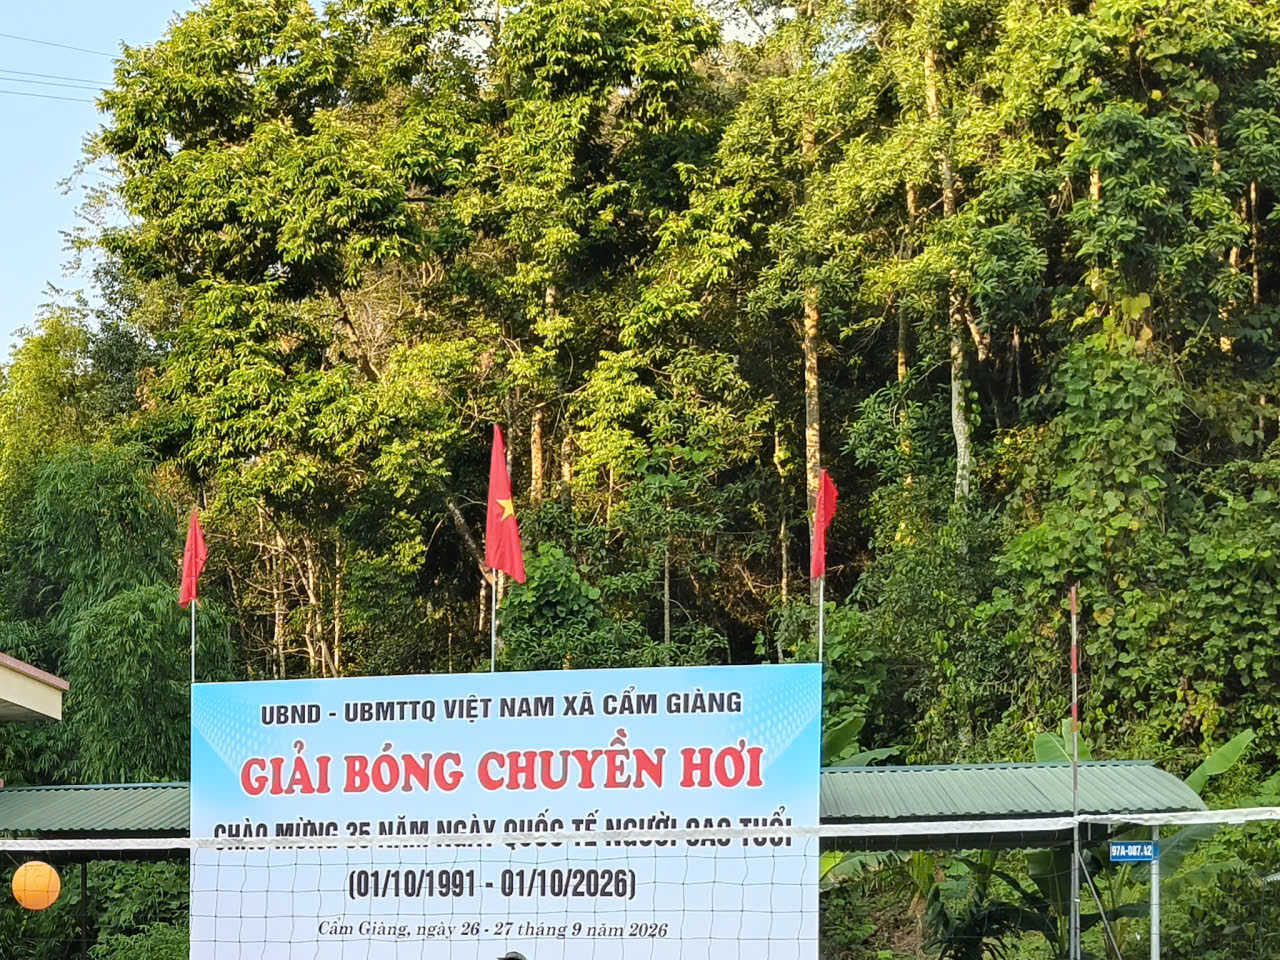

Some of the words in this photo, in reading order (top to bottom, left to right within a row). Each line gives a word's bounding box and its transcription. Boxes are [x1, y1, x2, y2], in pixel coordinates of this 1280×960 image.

[261, 704, 321, 725] UBND
[344, 700, 436, 722] UBMTTQ
[443, 694, 492, 723] VIỆT
[500, 696, 554, 718] NAM
[563, 691, 594, 716] XÃ
[602, 685, 658, 715] CẨM
[665, 688, 742, 714] GIÀNG
[240, 739, 332, 796] GIẢI
[343, 742, 464, 793] BÓNG
[477, 728, 666, 792] CHUYỀN
[679, 738, 764, 788] HƠI
[214, 817, 268, 851] CHÀO
[275, 816, 338, 850] MỪNG
[378, 815, 429, 848] NĂM
[437, 813, 496, 848] NGÀY
[504, 808, 564, 850] QUỐC
[571, 809, 599, 847] TẾ
[606, 810, 677, 847] NGƯỜI
[686, 817, 731, 847] CAO
[739, 806, 792, 848] TUỔI
[348, 869, 475, 900] (01/10/1991
[500, 868, 637, 900] 01/10/2026)
[318, 917, 354, 937] Cẩm
[358, 920, 412, 941] Giàng,
[416, 920, 456, 941] ngày
[460, 922, 481, 937] 26
[493, 922, 514, 937] 27
[518, 921, 567, 941] tháng
[572, 922, 582, 938] 9
[586, 921, 624, 938] năm
[628, 922, 669, 940] 2026
